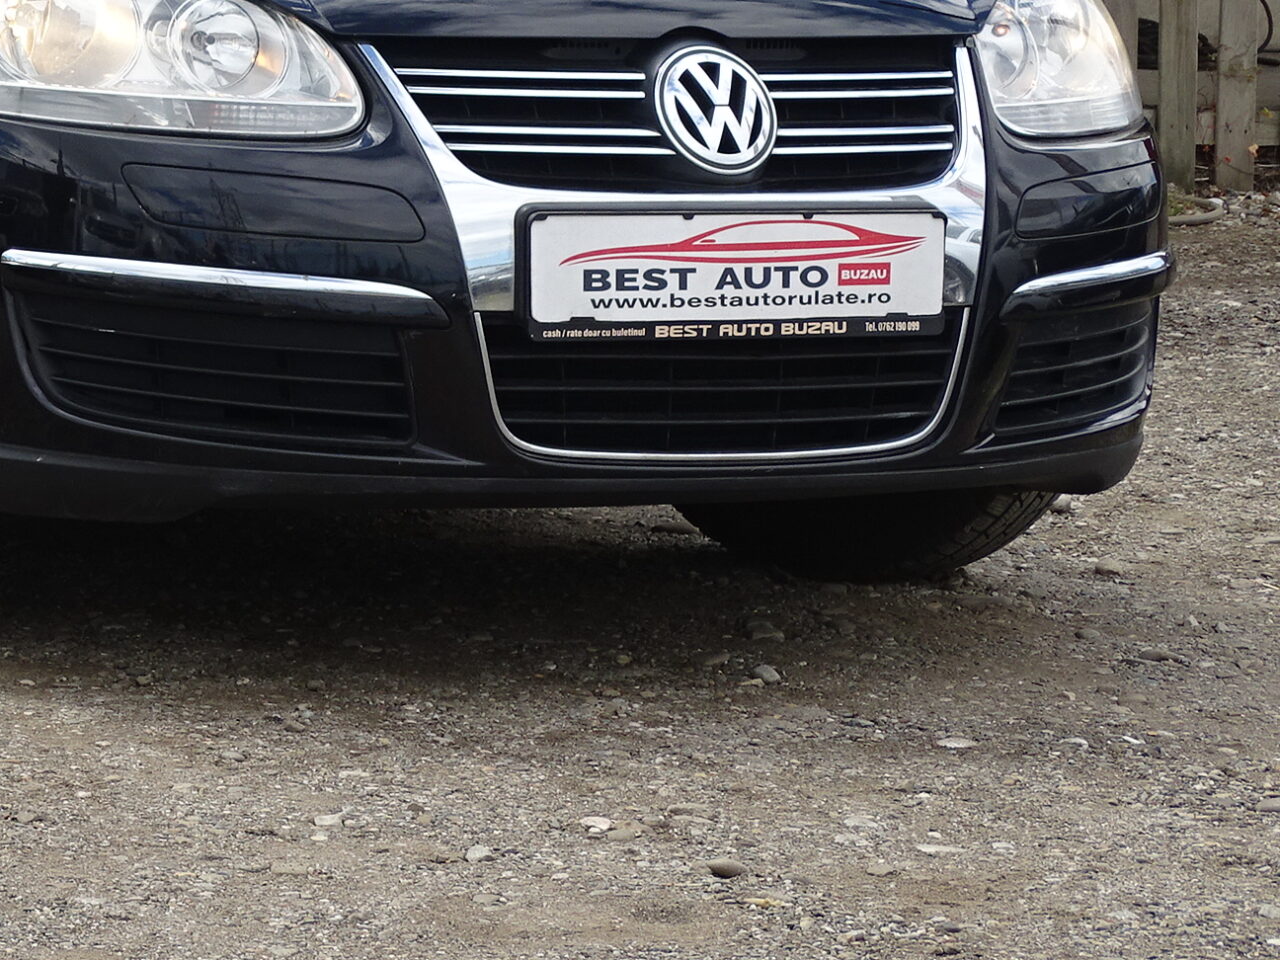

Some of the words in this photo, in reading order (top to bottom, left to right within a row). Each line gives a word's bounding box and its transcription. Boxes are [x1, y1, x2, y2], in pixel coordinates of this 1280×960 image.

[582, 267, 697, 292] BEST
[714, 264, 830, 290] AUTO
[840, 267, 888, 281] BUZAU
[590, 291, 892, 309] www.bestautorulate.ro
[543, 328, 561, 338] cash
[567, 329, 583, 338] rate
[583, 328, 601, 338] doar
[601, 329, 611, 337] cu
[612, 328, 646, 337] buletinul
[655, 324, 712, 338] BEST
[719, 323, 773, 337] AUTO
[781, 321, 847, 335] BUZAU
[865, 321, 877, 332] Tel.
[878, 321, 895, 332] 0762
